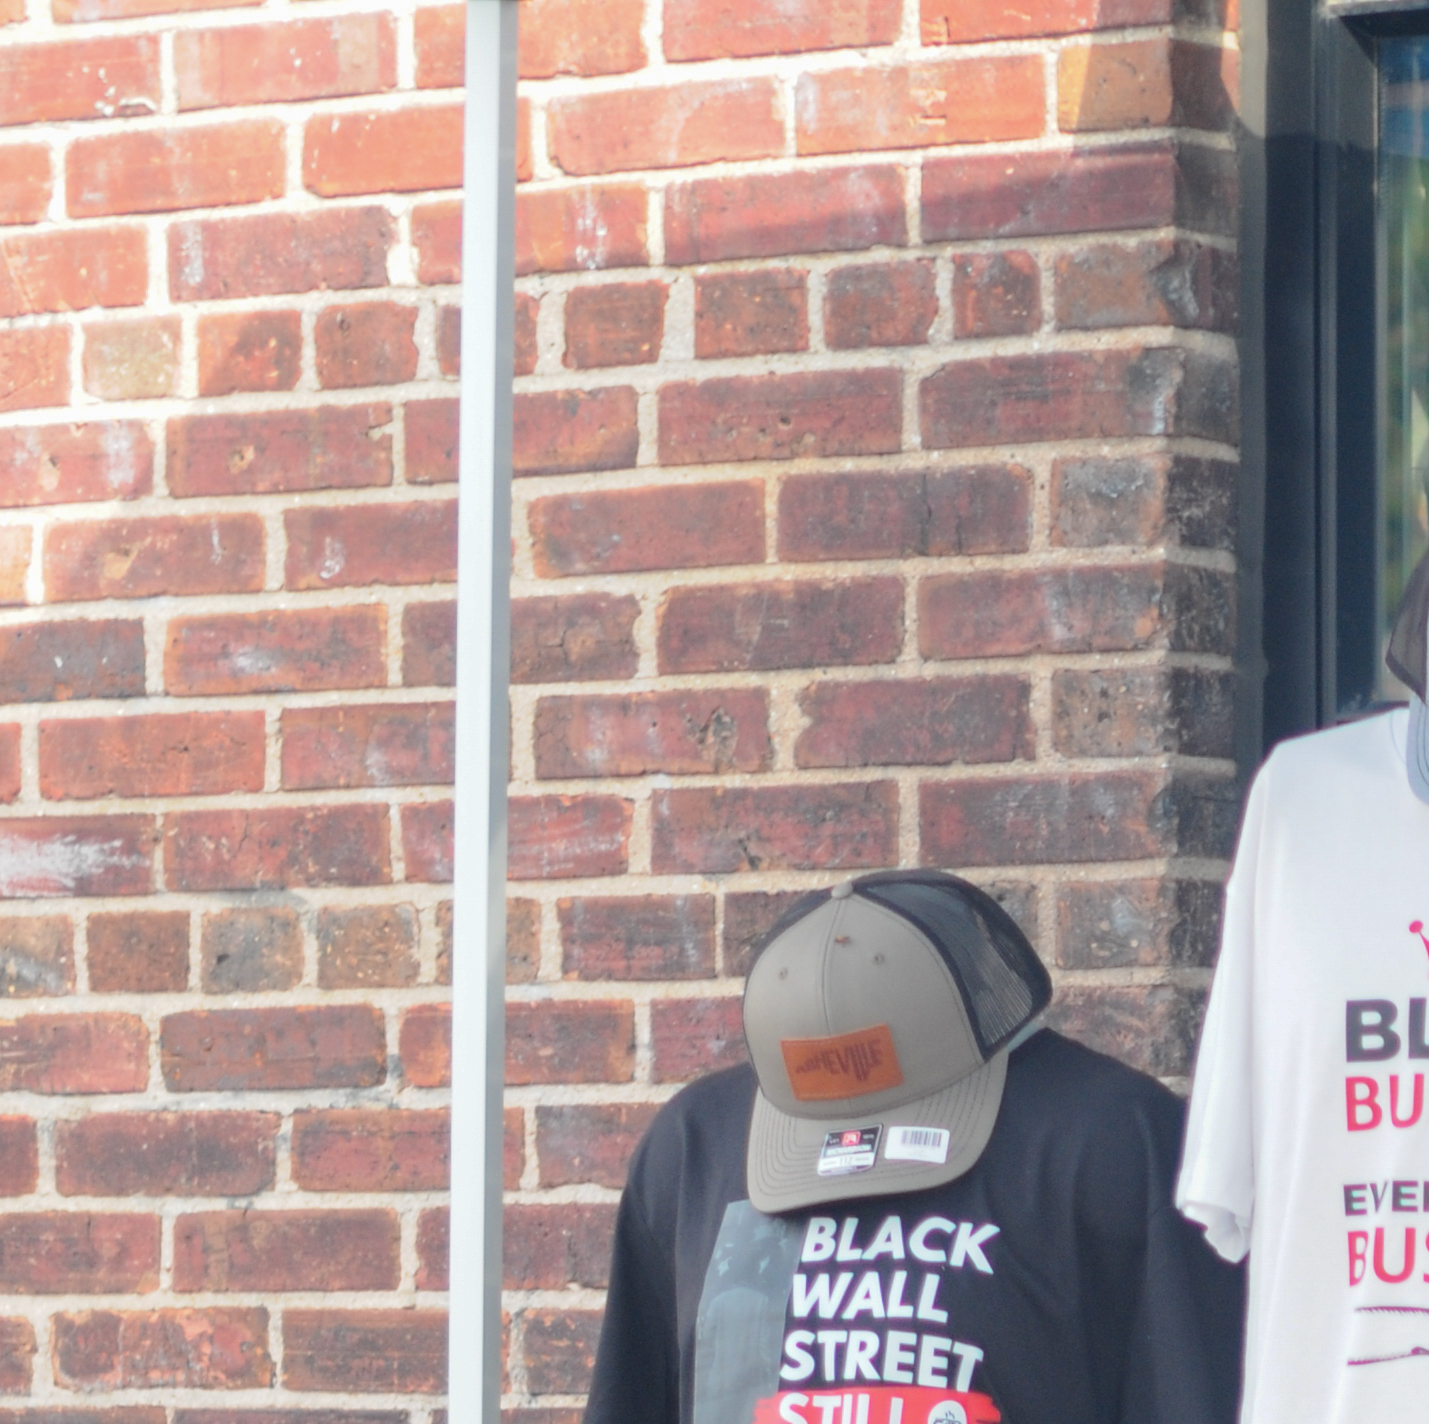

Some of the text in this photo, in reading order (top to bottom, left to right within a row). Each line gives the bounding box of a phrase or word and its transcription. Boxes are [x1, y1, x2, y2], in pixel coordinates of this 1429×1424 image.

[800, 1216, 1000, 1275] BLACK
[790, 1271, 948, 1323] WALL
[780, 1329, 983, 1392] STREET
